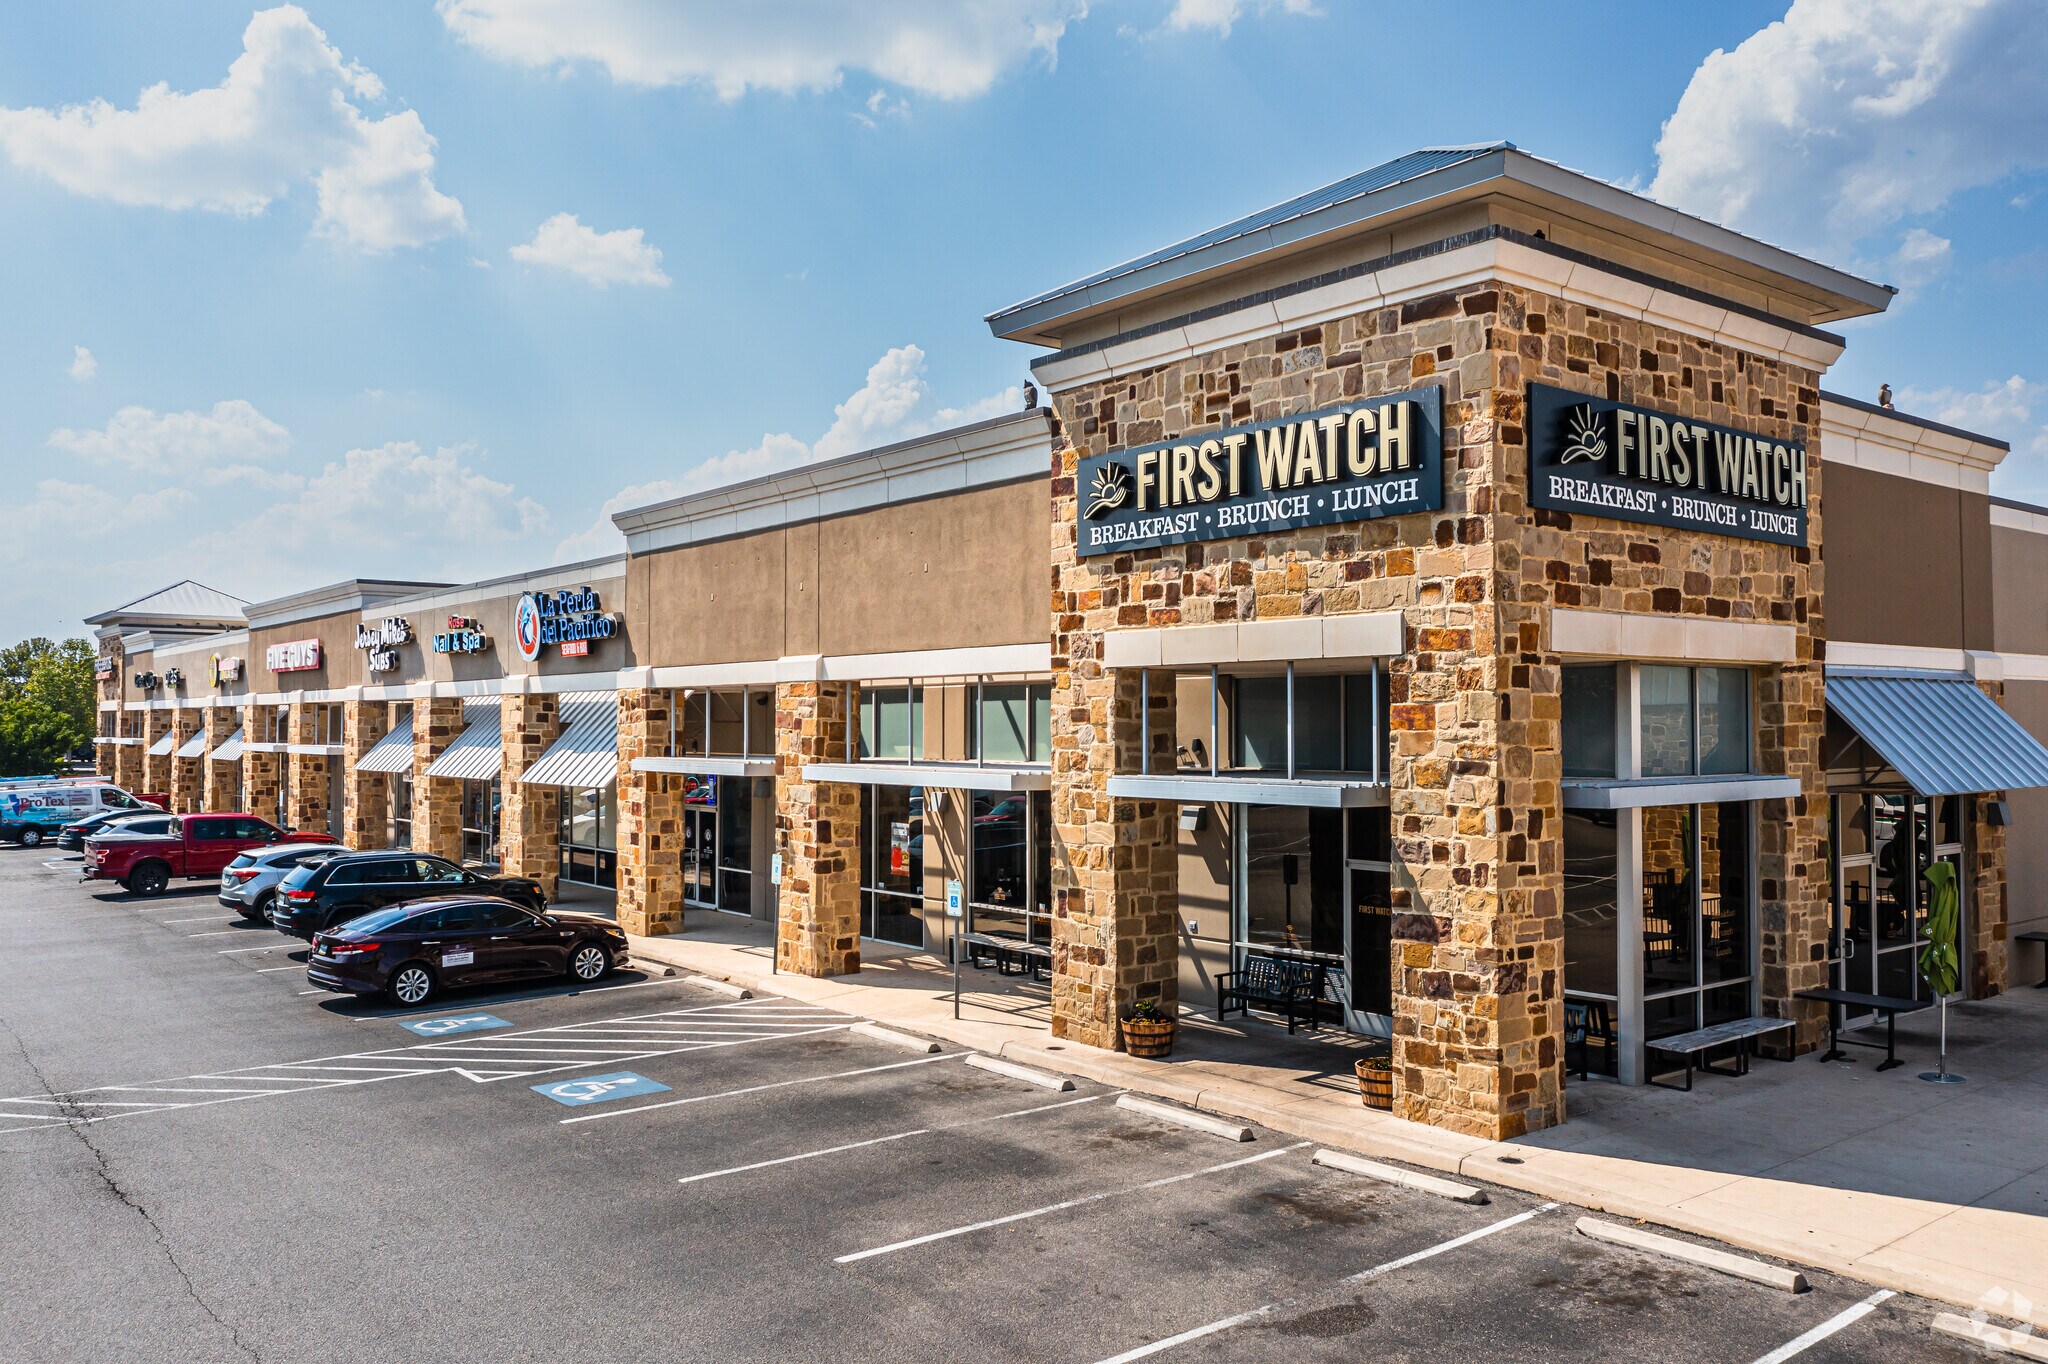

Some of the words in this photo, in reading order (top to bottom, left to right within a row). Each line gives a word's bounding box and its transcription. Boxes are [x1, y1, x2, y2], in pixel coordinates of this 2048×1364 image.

[1136, 432, 1248, 512] FIRST
[1254, 400, 1413, 492] WATCH
[1616, 408, 1709, 490] FIRST
[1713, 430, 1807, 509] WATCH
[1089, 511, 1200, 547] BREAKFAST
[1217, 494, 1311, 529] BRUNCH
[1331, 477, 1420, 513] LUNCH
[1548, 475, 1657, 514] BREAKFAST
[1671, 496, 1738, 527] BRUNCH
[1749, 509, 1799, 537] LUNCH
[538, 593, 556, 618] La
[557, 586, 596, 615] Perla
[354, 624, 381, 653] Jersey
[381, 617, 408, 645] Mike's
[447, 616, 465, 630] Rose
[541, 618, 559, 644] del
[266, 644, 289, 671] FIVE
[287, 641, 317, 669] GUYS
[432, 634, 451, 654] Nail
[452, 631, 461, 652] &
[462, 631, 481, 654] Spa
[20, 796, 66, 807] ProTex
[1358, 904, 1375, 915] FIRST
[1374, 906, 1392, 917] WATC
